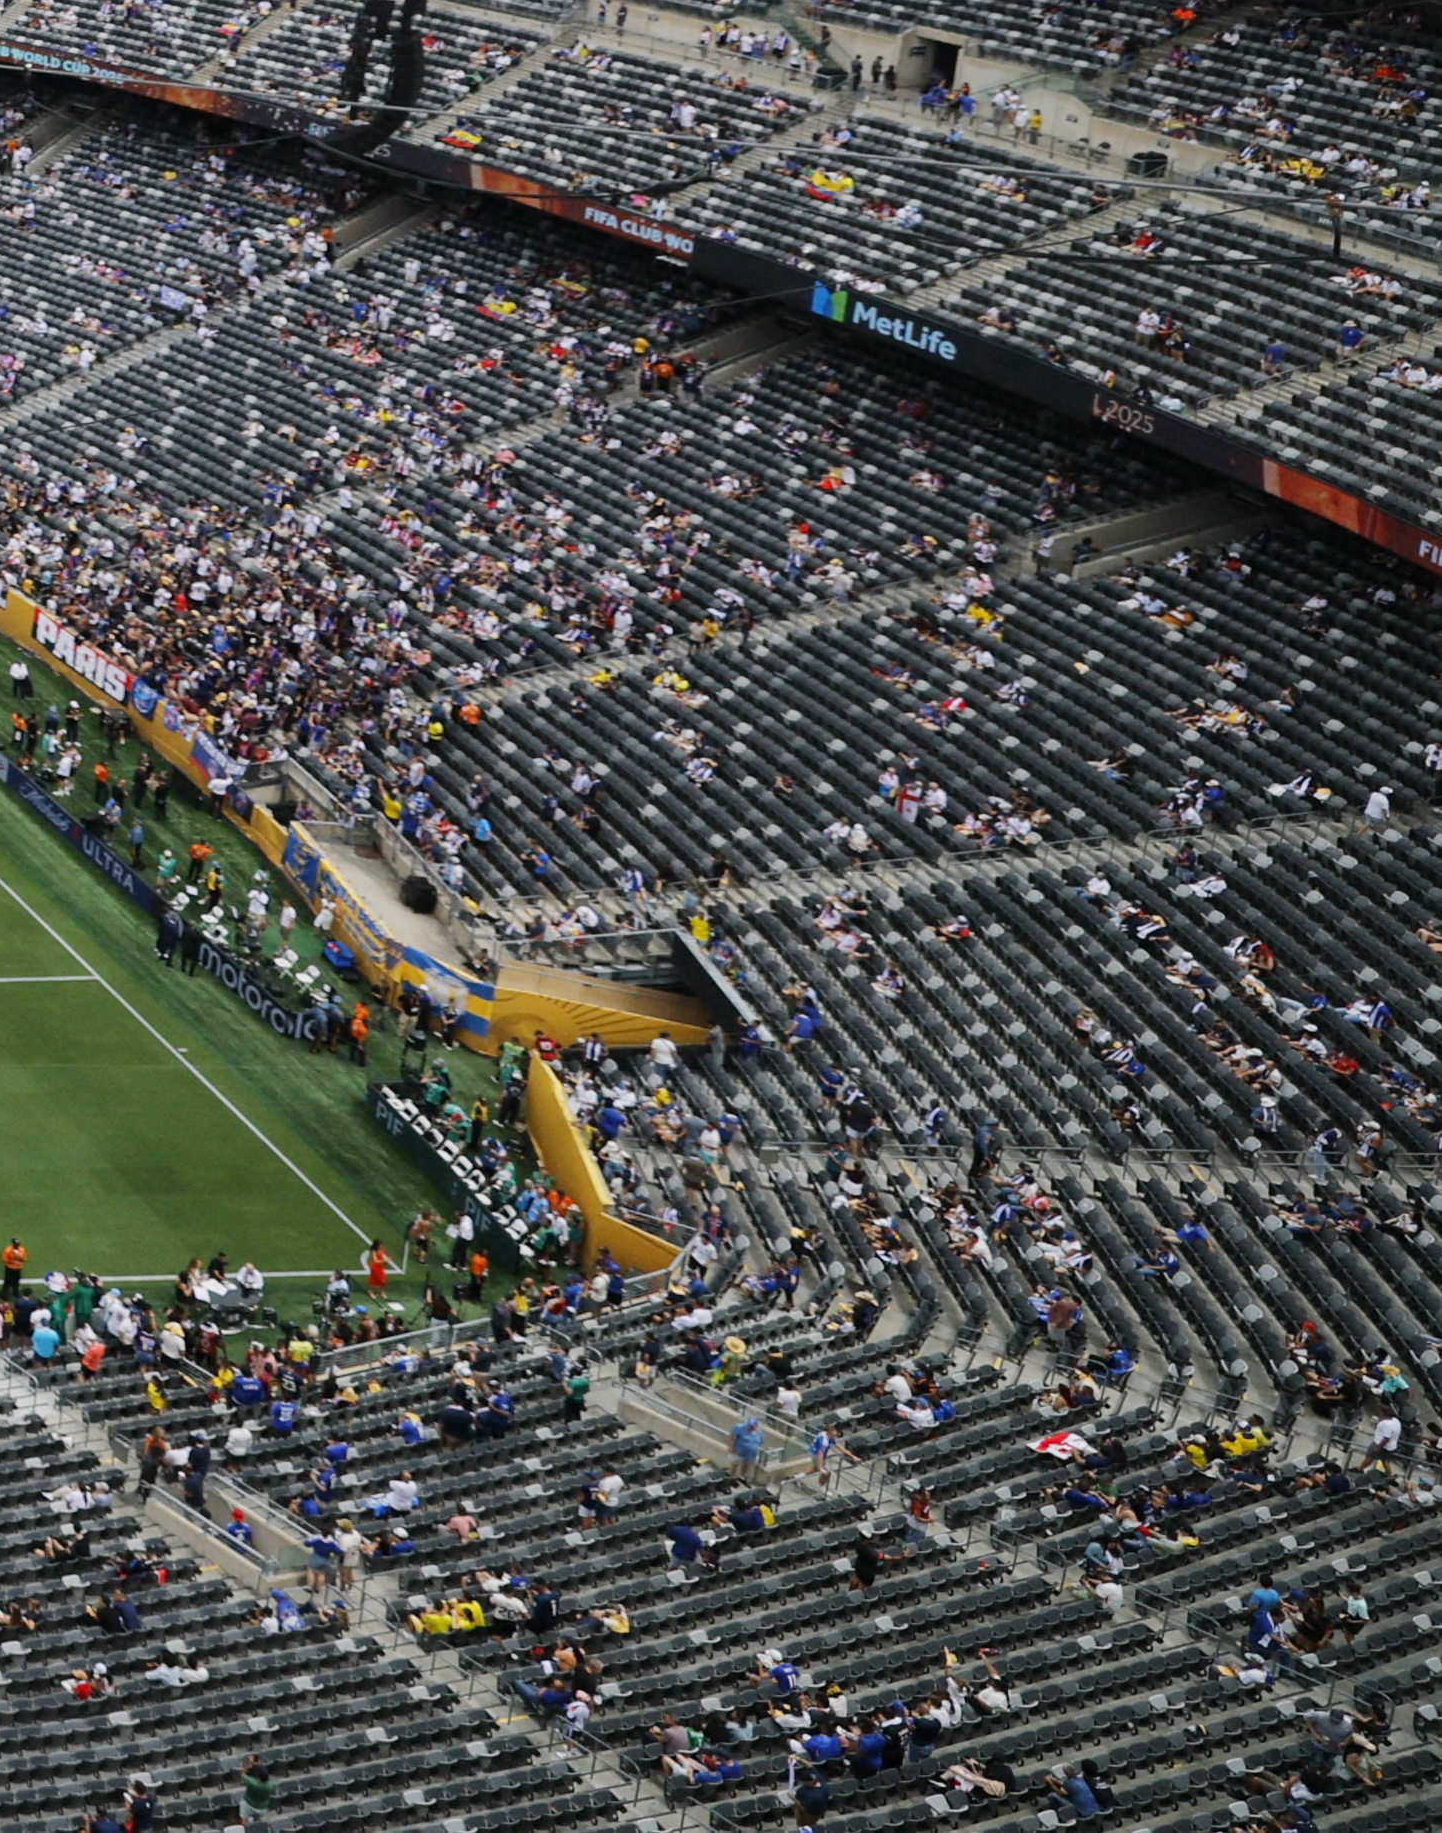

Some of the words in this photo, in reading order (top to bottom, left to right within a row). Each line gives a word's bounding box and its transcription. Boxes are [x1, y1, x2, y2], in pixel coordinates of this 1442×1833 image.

[10, 48, 61, 68] WORLD
[62, 59, 91, 74] CUP
[584, 206, 619, 229] FIFA
[620, 219, 664, 243] CLUB
[852, 300, 957, 361] MetLife
[1105, 400, 1154, 434] 2025
[36, 611, 129, 701] PARIS
[82, 834, 134, 894] ULTRA
[376, 1099, 404, 1135] PIF
[465, 1196, 492, 1232] PIF
